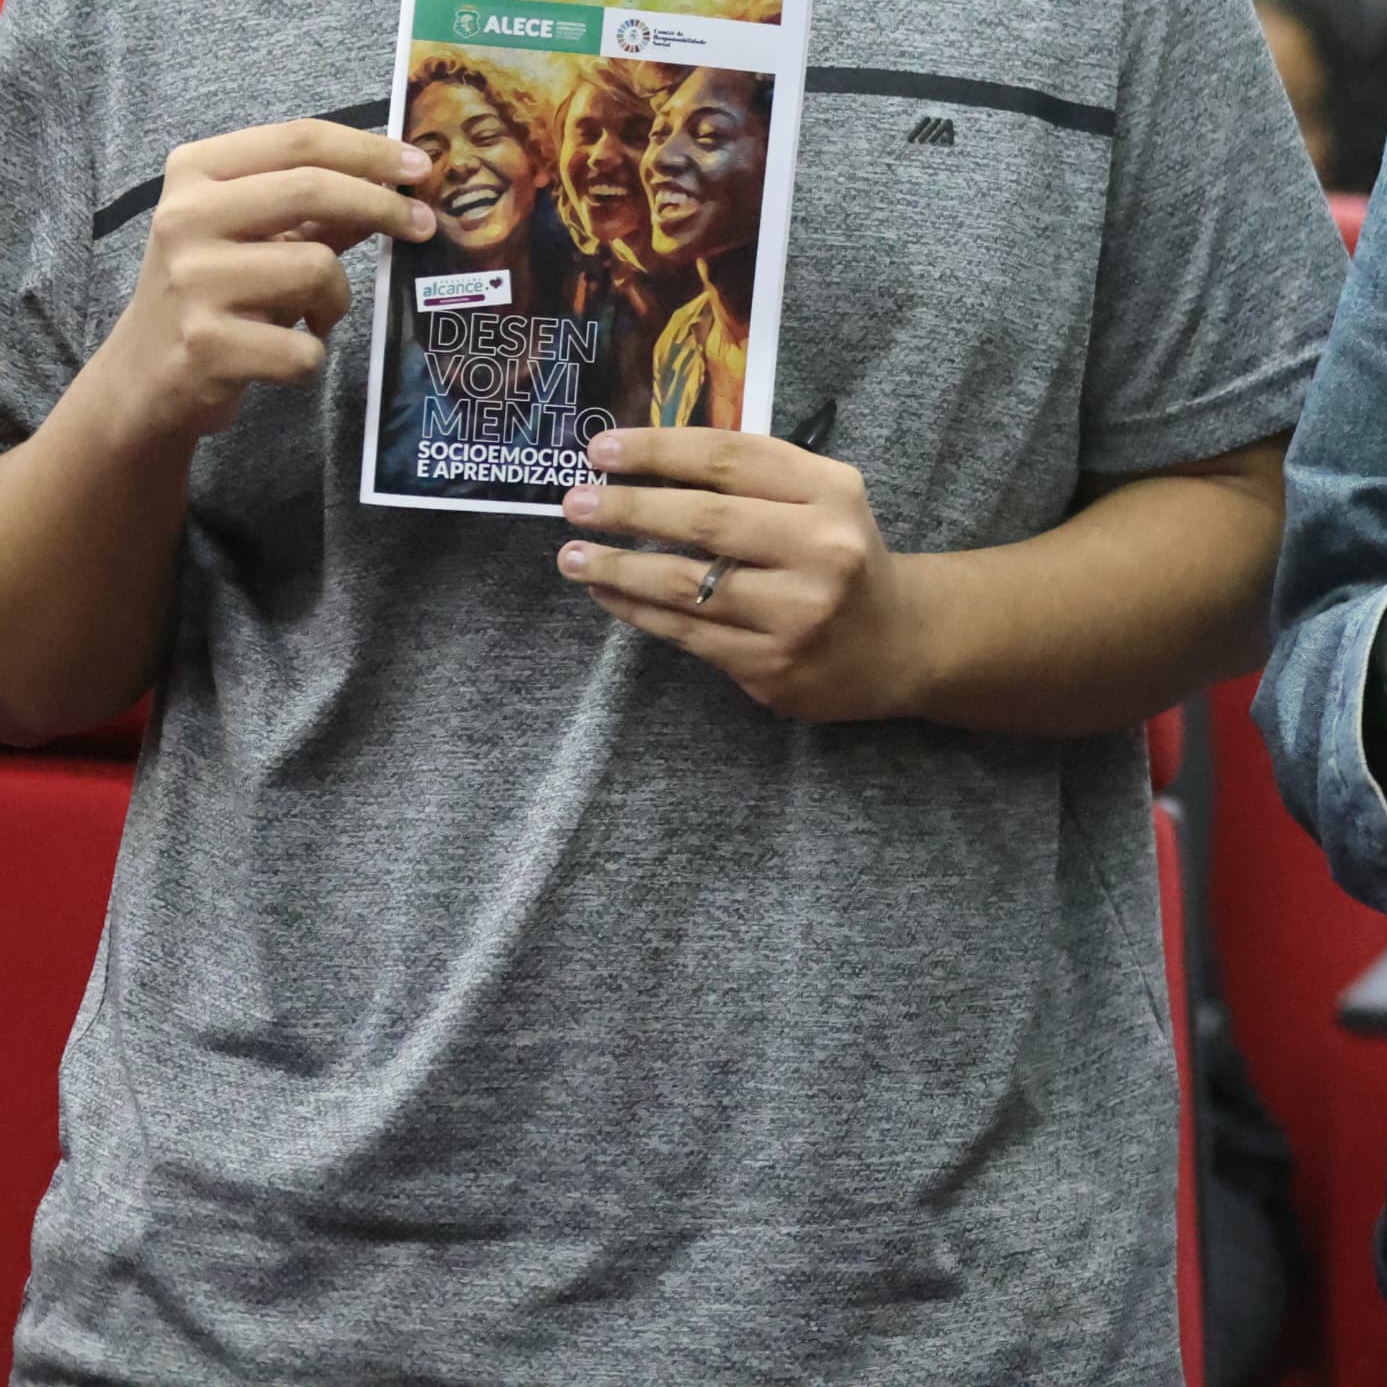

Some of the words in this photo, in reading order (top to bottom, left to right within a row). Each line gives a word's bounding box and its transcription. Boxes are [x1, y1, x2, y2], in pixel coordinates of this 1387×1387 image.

[483, 14, 553, 39] ALECE
[428, 310, 599, 364] DESEN
[424, 352, 580, 405] VOLVI
[422, 396, 617, 449] MENTO
[416, 460, 430, 478] E
[432, 461, 608, 487] APRENDIZAGEM
